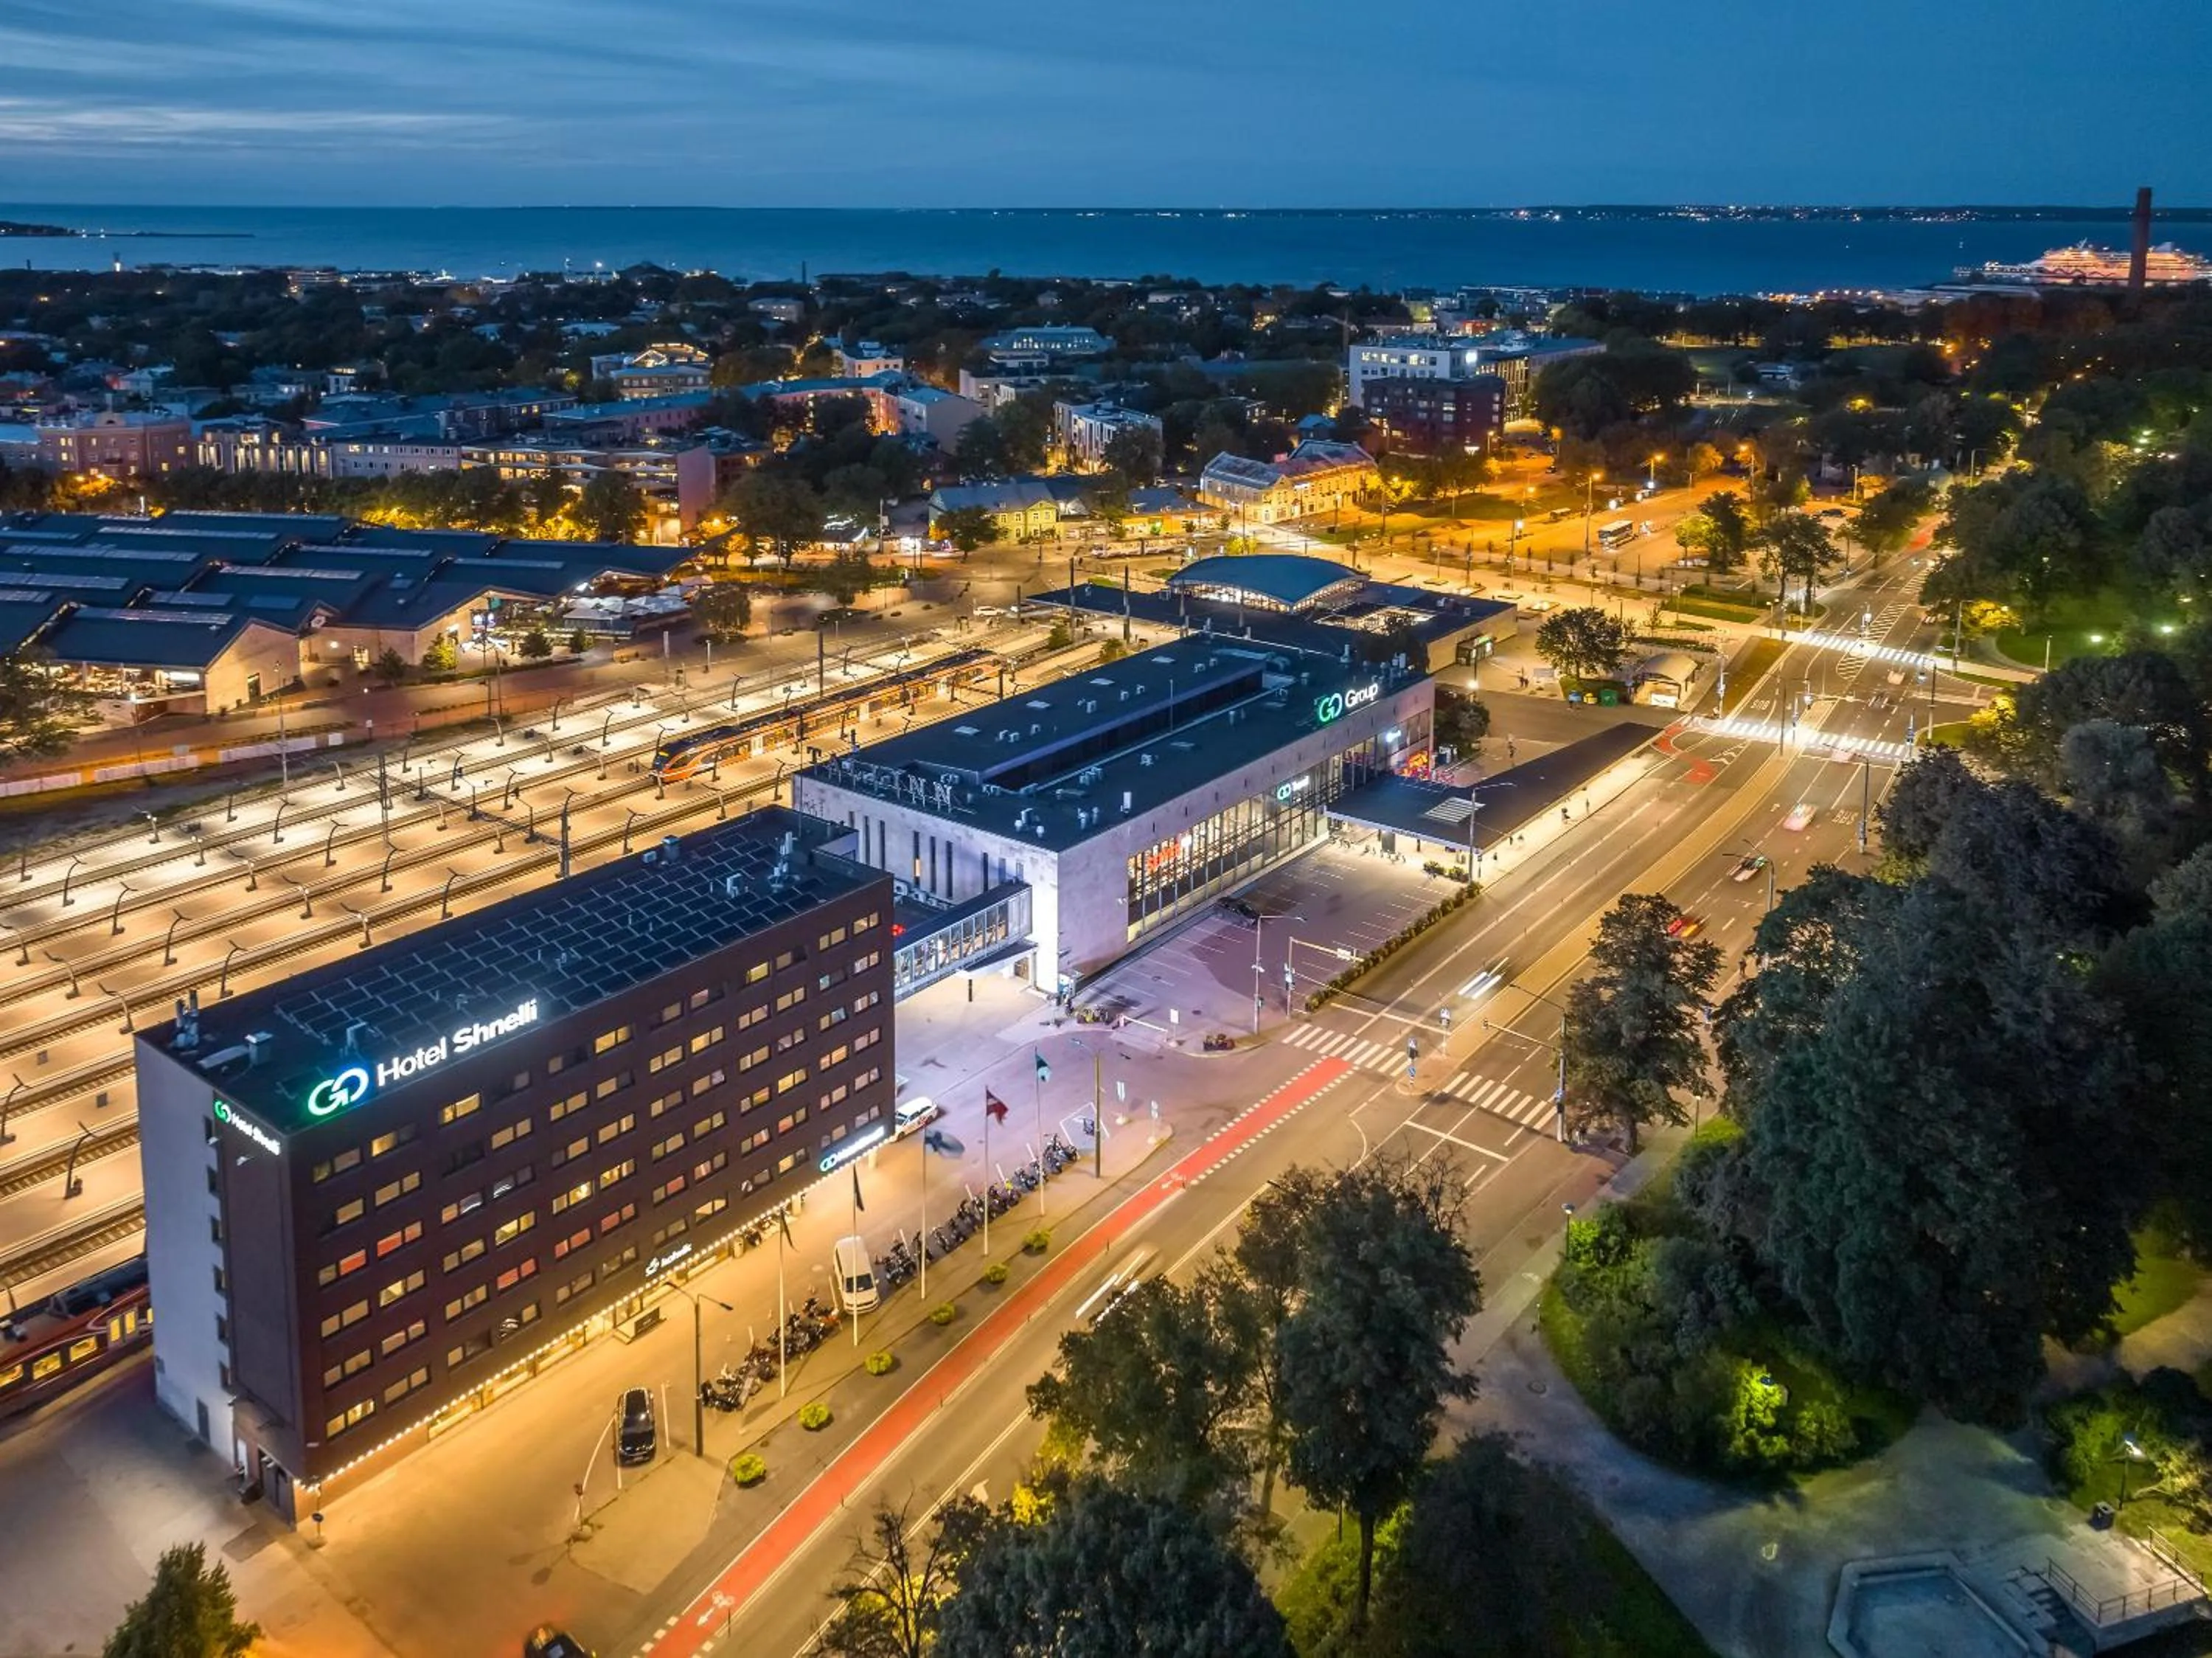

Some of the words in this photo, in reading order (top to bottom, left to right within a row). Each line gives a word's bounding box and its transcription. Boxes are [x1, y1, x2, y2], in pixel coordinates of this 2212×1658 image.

[1345, 683, 1379, 708] Group
[377, 1036, 447, 1087] Hotel
[453, 998, 538, 1053] Shnelli
